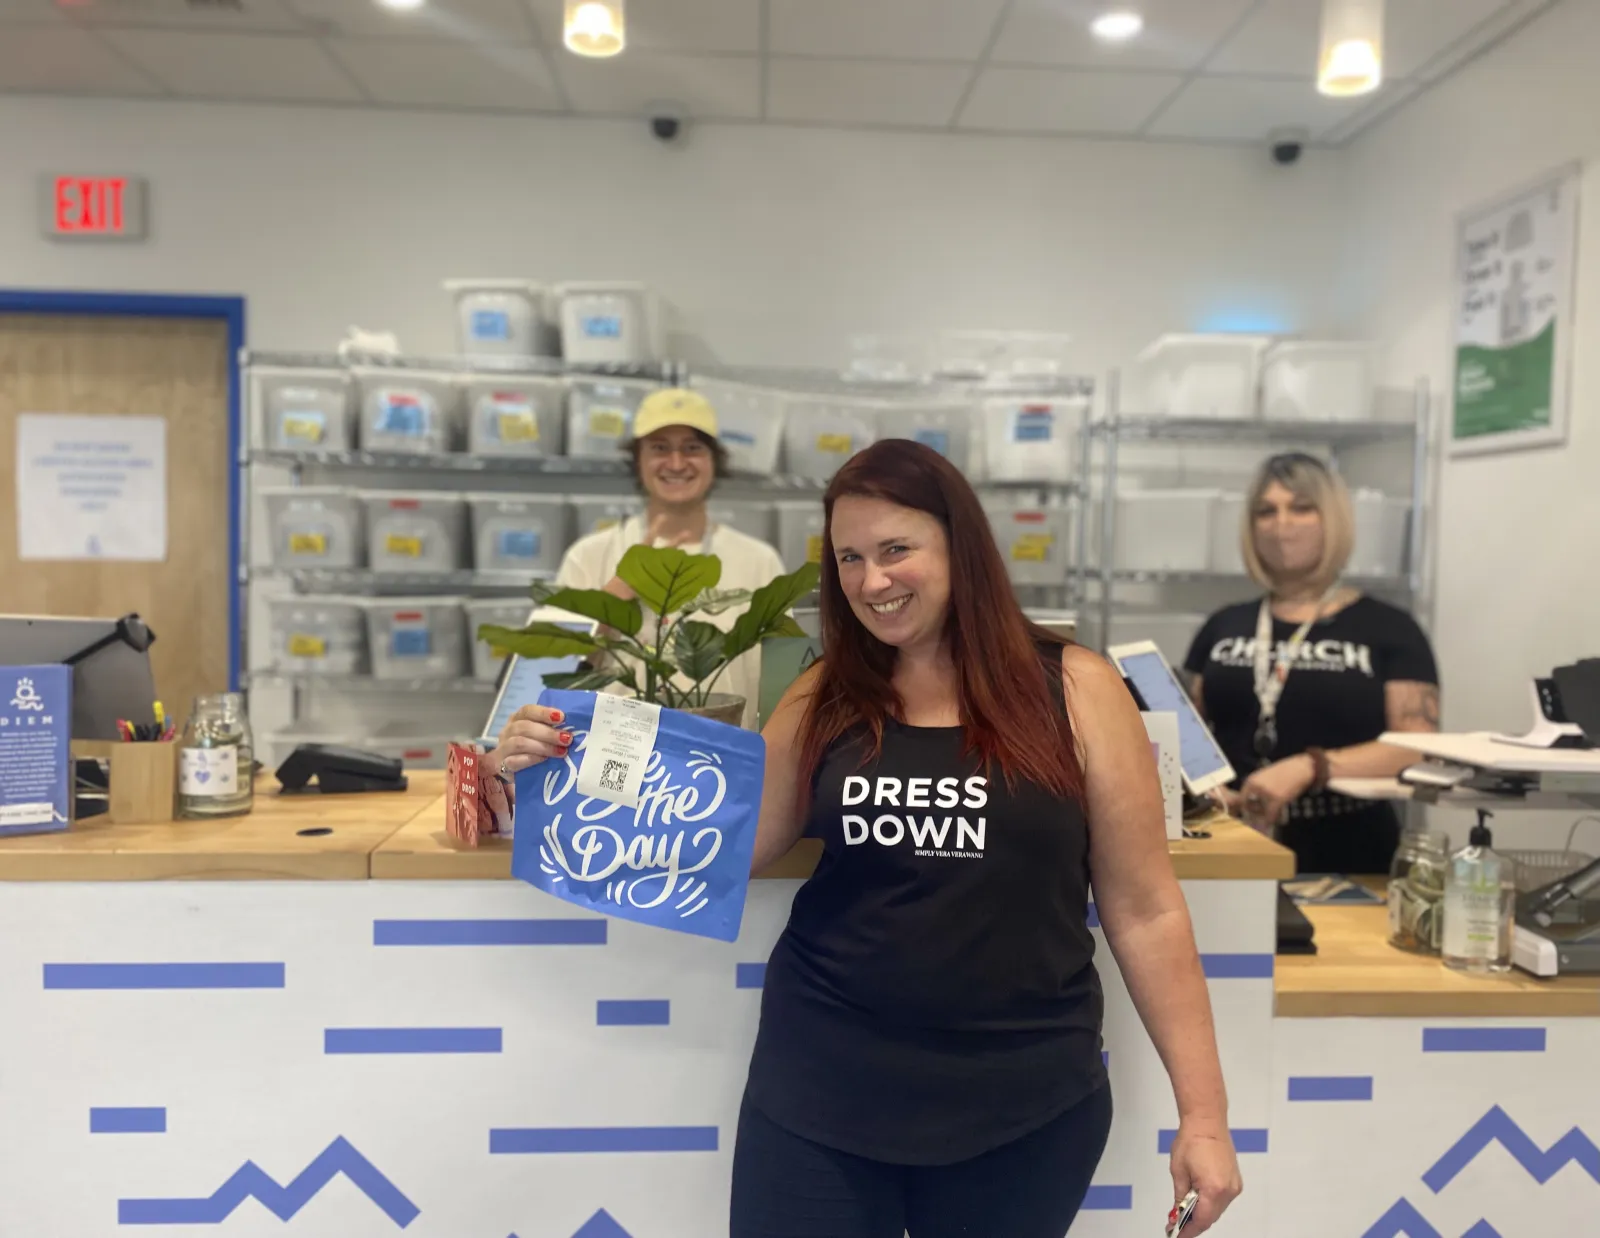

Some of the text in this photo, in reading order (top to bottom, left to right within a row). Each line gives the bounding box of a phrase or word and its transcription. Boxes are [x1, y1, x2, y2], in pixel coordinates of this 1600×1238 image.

[56, 177, 126, 232] EXIT
[1209, 637, 1375, 677] CHRCH
[0, 715, 53, 726] DIEM
[463, 756, 474, 767] POP
[461, 783, 476, 795] DROP
[633, 766, 726, 828] the
[842, 775, 988, 809] DRESS
[842, 814, 986, 850] DOWN
[560, 819, 722, 909] Day
[914, 849, 935, 857] SIMPLY
[935, 850, 951, 858] VERA
